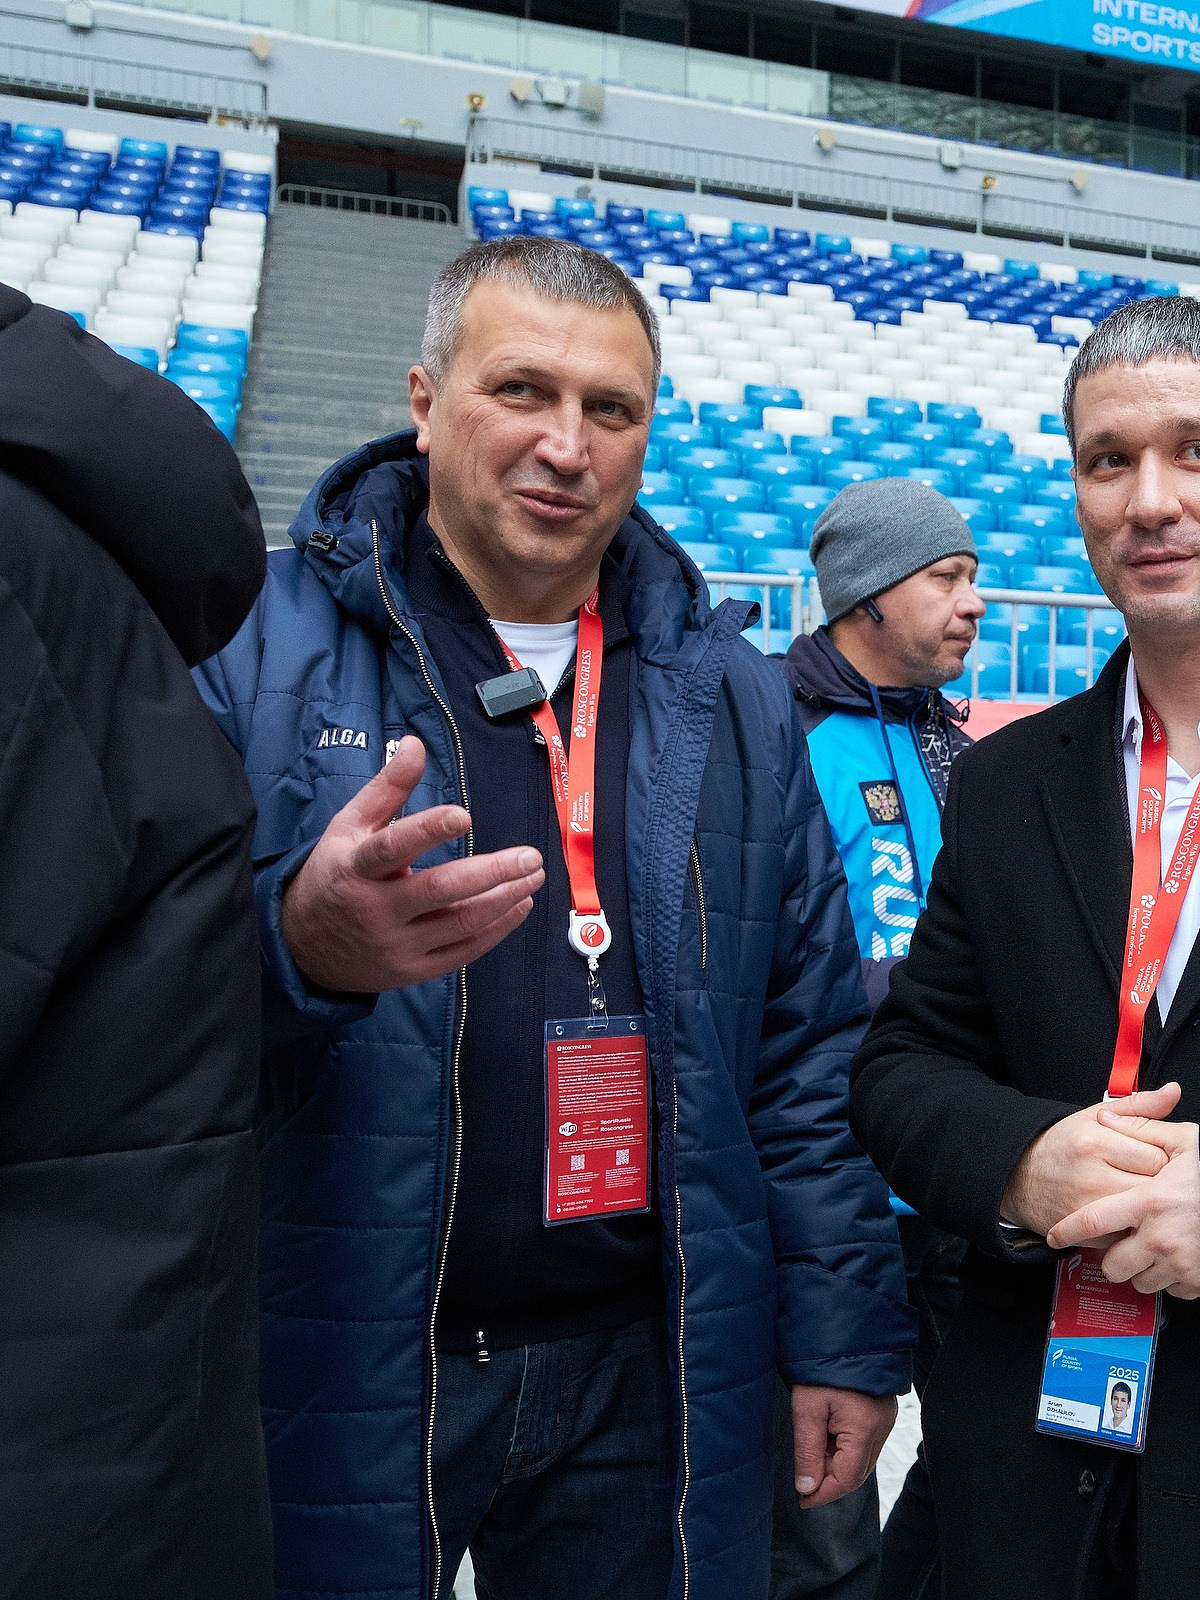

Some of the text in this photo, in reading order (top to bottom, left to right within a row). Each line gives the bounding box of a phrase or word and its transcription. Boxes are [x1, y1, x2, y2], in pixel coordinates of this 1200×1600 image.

[576, 649, 592, 725] ROSCONGRESS
[318, 729, 368, 748] ALGA
[1181, 865, 1193, 881] Fight
[1189, 843, 1200, 857] Win
[1139, 961, 1153, 993] COUNTRY
[1147, 958, 1161, 984] SPORTS
[600, 1117, 632, 1125] SportRussia
[600, 1124, 634, 1132] Roscongress
[1109, 1365, 1140, 1381] 2025
